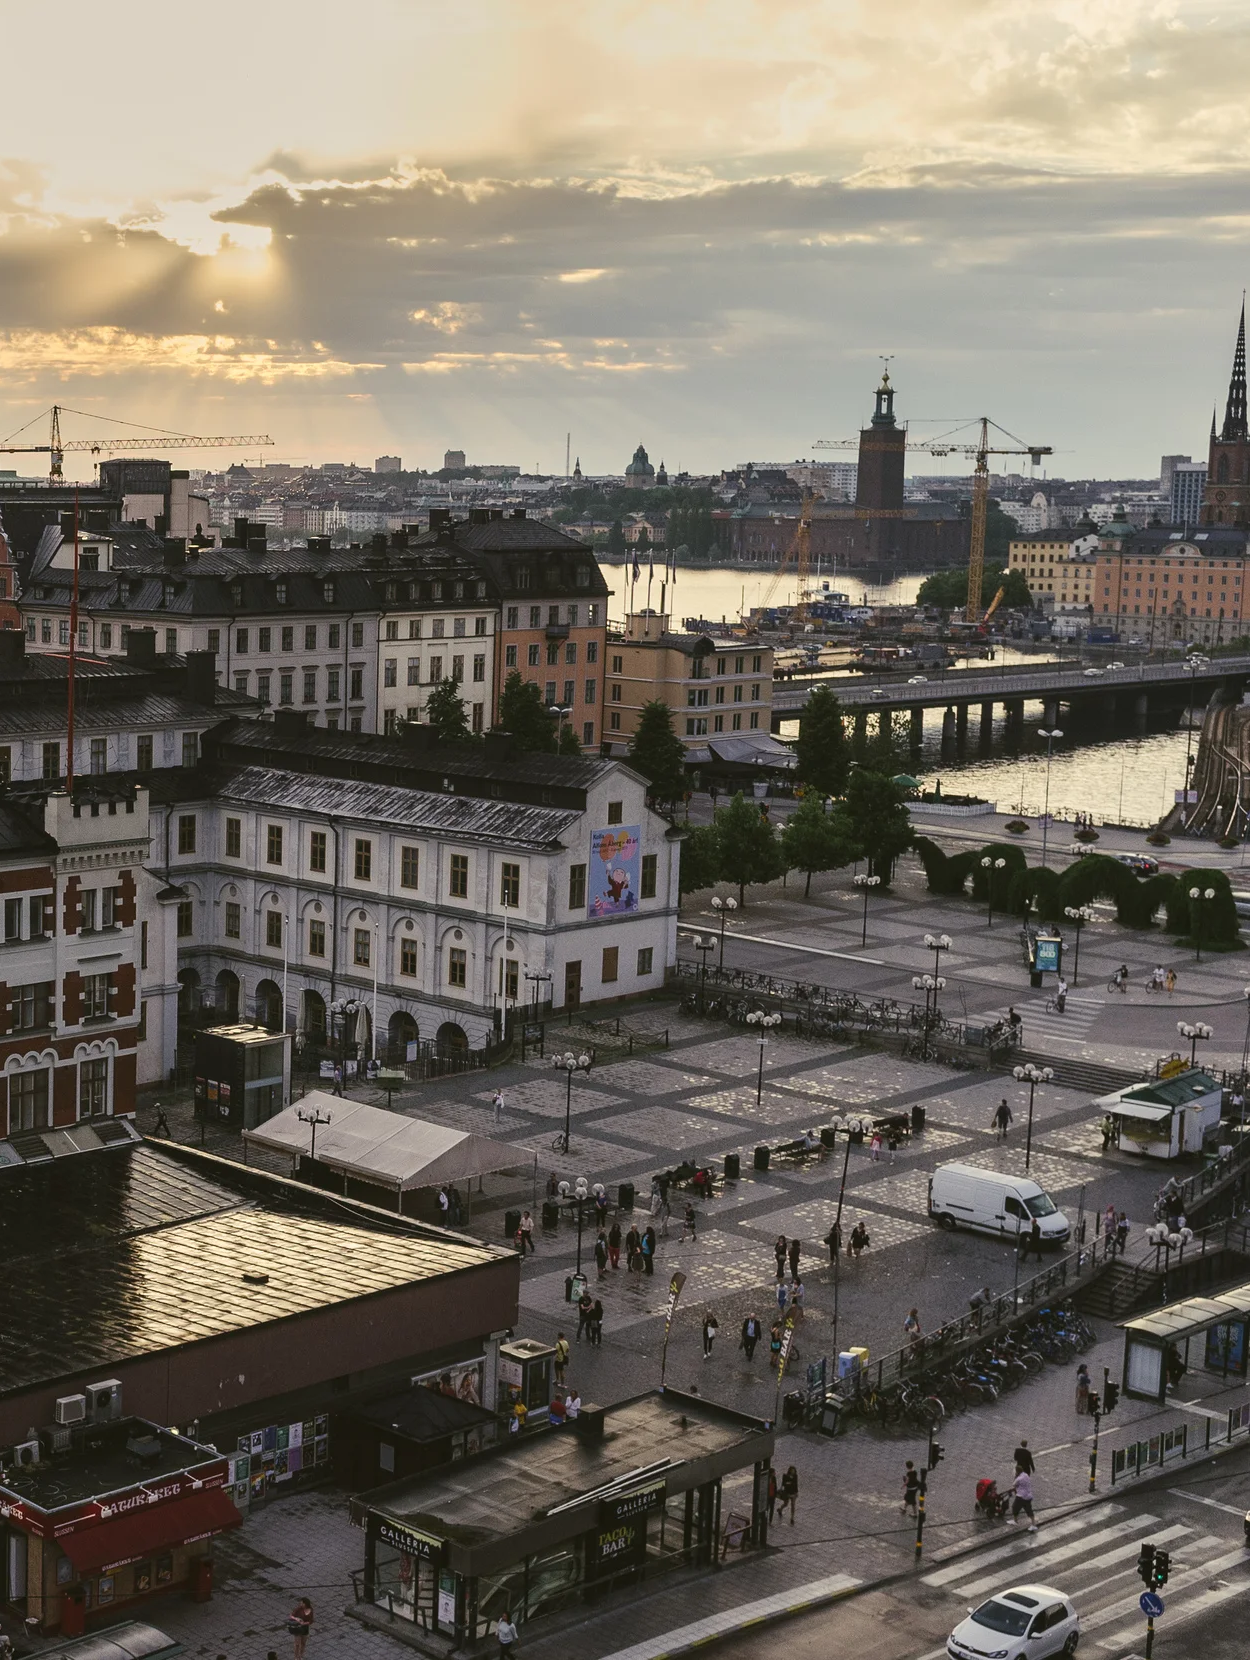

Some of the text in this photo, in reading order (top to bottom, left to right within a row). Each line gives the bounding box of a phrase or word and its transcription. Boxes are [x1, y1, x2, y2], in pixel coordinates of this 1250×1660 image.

[780, 1329, 792, 1357] BAR
[616, 1492, 657, 1515] GALLERIA
[380, 1526, 430, 1554] GALLERIA
[599, 1526, 627, 1546] TACO
[602, 1537, 626, 1556] BAR
[391, 1540, 419, 1556] SLUSSEN
